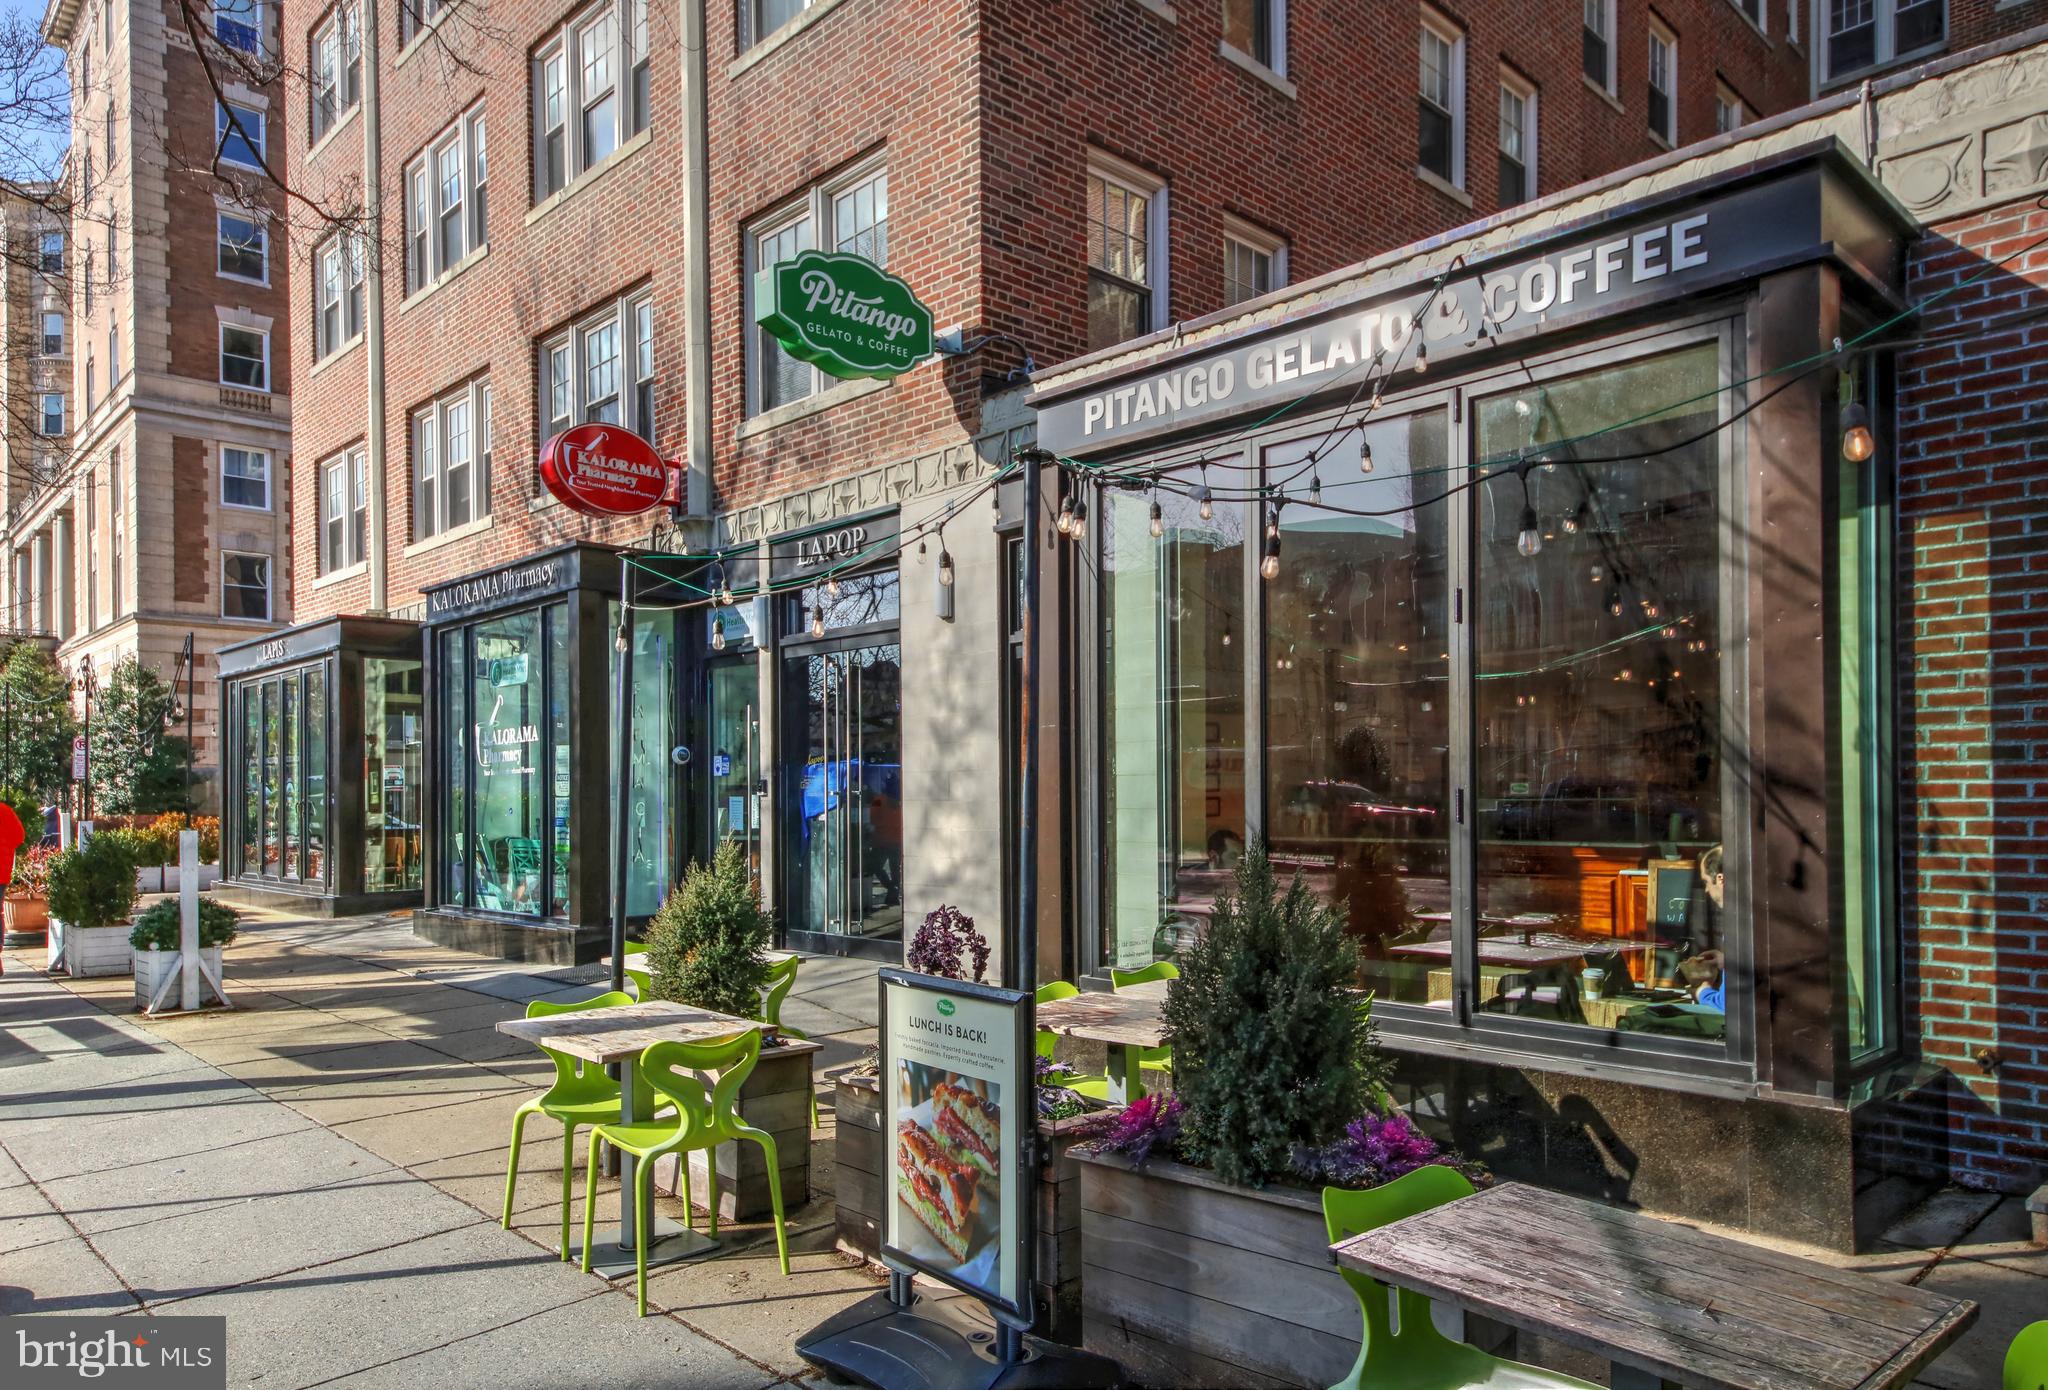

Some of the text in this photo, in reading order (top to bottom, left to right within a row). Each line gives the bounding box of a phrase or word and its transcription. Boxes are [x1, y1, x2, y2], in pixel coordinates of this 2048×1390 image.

[800, 270, 917, 341] Pitango
[806, 322, 909, 358] GELATO & COFFEE
[1083, 213, 1709, 435] PITANGO GELATO & COFFEE
[577, 450, 662, 479] KALORAMA
[577, 463, 638, 488] Pharmacy
[797, 526, 864, 566] LAPOP
[432, 562, 555, 612] KALORAMA Pharmacy
[262, 640, 285, 660] LAPIS
[909, 1015, 987, 1044] LUNCH IS BACK!
